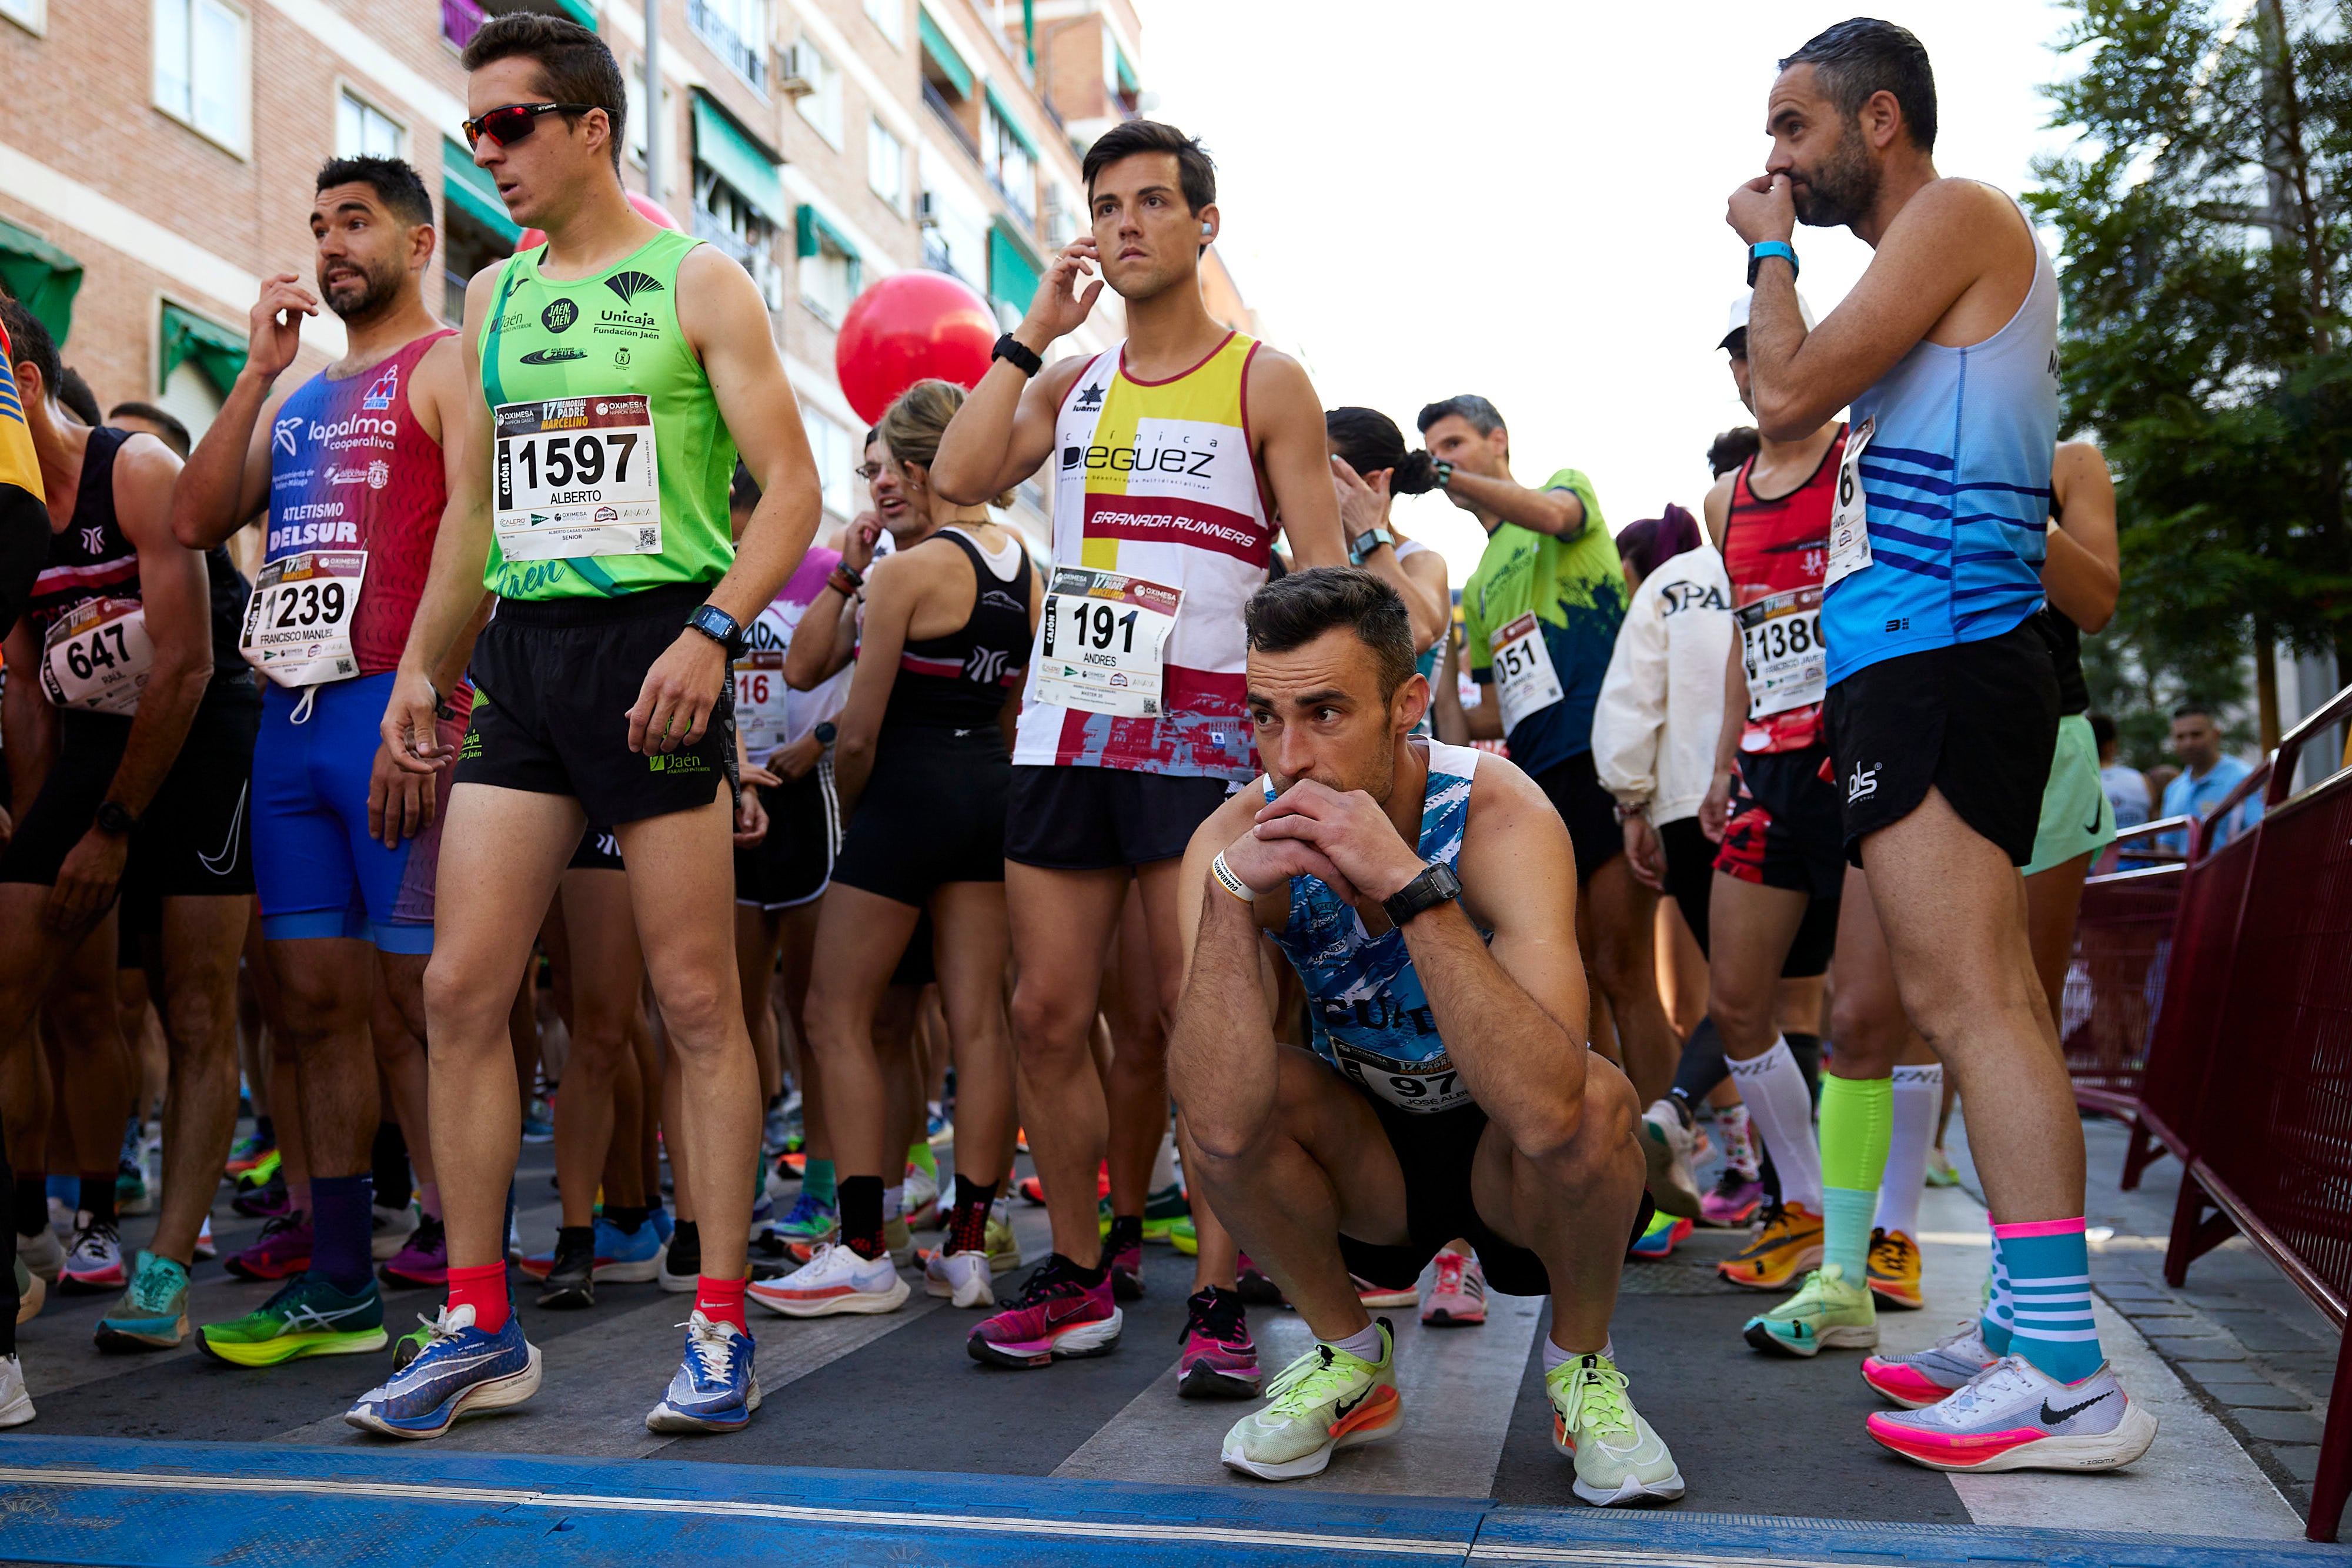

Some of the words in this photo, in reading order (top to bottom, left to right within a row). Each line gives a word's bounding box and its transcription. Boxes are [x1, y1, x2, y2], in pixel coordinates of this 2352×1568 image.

[499, 311, 523, 330] Jaén
[601, 310, 654, 325] Unicaja
[593, 326, 638, 337] Fundación
[639, 330, 659, 340] Jaén
[504, 410, 534, 420] OXIMESA
[542, 402, 559, 420] 17
[557, 399, 586, 409] MEMORIAL
[557, 407, 584, 418] PADRE
[308, 413, 397, 447] lapalma
[541, 416, 588, 430] MARCELINO
[329, 436, 395, 452] cooperativa
[519, 433, 637, 489] 1597
[502, 462, 510, 495] CAJÓN
[550, 490, 602, 504] ALBERTO
[282, 502, 345, 523] ATLETISMO
[269, 521, 358, 552] DELSUR
[1091, 511, 1171, 527] GRANADA
[1172, 516, 1257, 547] RUNNERS
[493, 559, 565, 599] Jaén
[1062, 573, 1087, 583] OXIMESA
[1092, 574, 1107, 588] 17
[1102, 581, 1125, 591] PADRE
[1087, 588, 1126, 600] MARCELINO
[1145, 587, 1176, 601] OXIMESA
[265, 583, 345, 629] 1239
[1046, 613, 1055, 644] CAJÓN
[1074, 603, 1138, 653] 191
[260, 631, 301, 645] FRANCISCO
[302, 628, 333, 641] MANUEL
[67, 623, 131, 680] 647
[1084, 653, 1117, 667] ANDRES
[666, 753, 700, 769] Jaén
[1351, 1047, 1388, 1064] OXIMESA
[1398, 1062, 1418, 1071] 17
[1398, 1063, 1453, 1075] MARCELIN
[1420, 1059, 1451, 1070] PADR
[1389, 1069, 1458, 1098] 97
